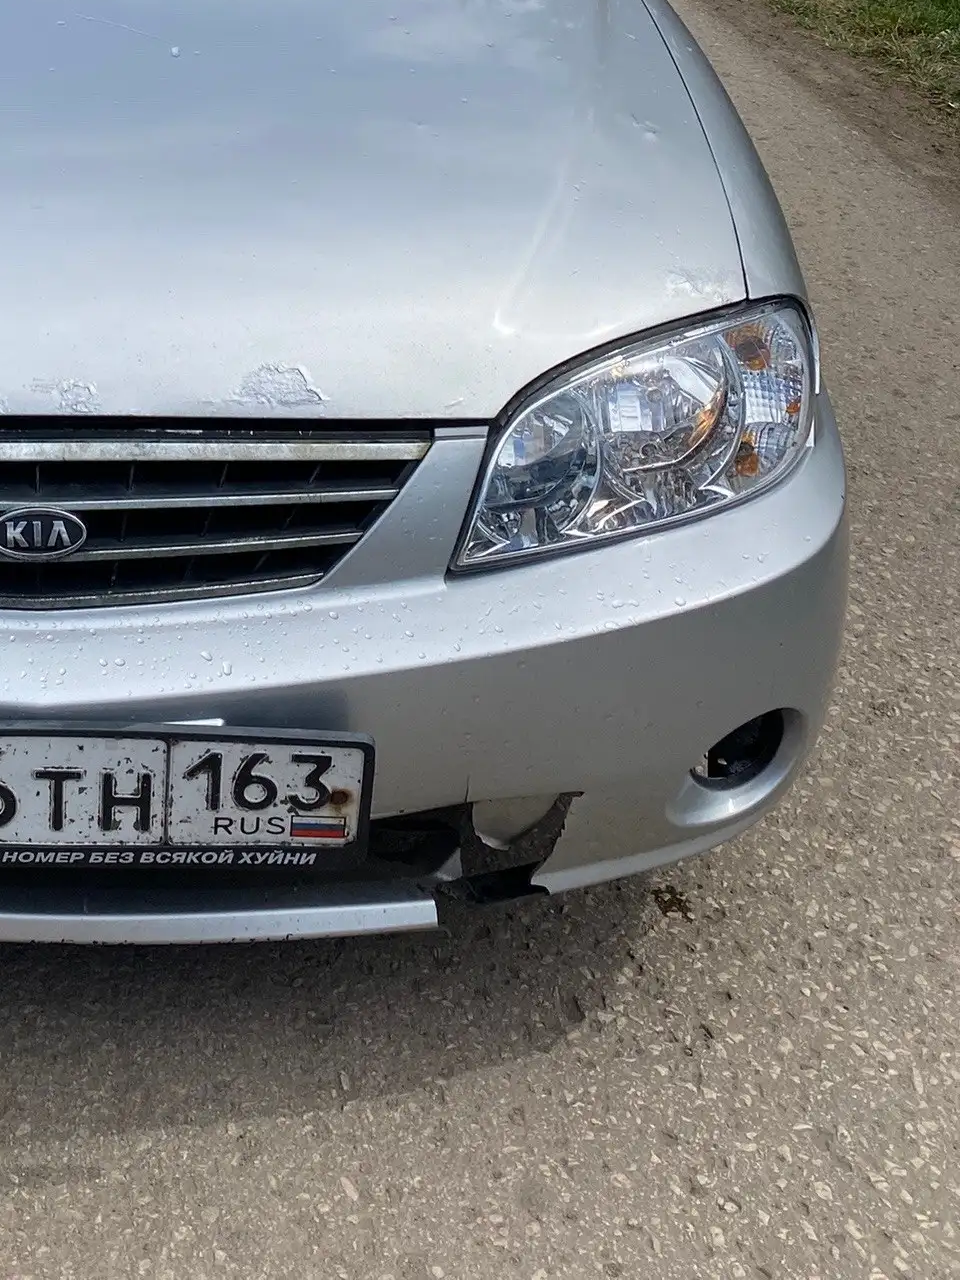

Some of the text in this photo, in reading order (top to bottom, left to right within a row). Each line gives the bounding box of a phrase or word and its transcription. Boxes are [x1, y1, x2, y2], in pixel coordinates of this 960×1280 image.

[5, 520, 72, 548] KIA
[183, 751, 333, 811] 163
[213, 816, 286, 835] RUS
[2, 851, 85, 864] НОМЕР
[89, 852, 134, 864] БЕЗ
[139, 849, 234, 865] ВСЯКОЙ
[238, 849, 317, 865] ХУЙНИ
